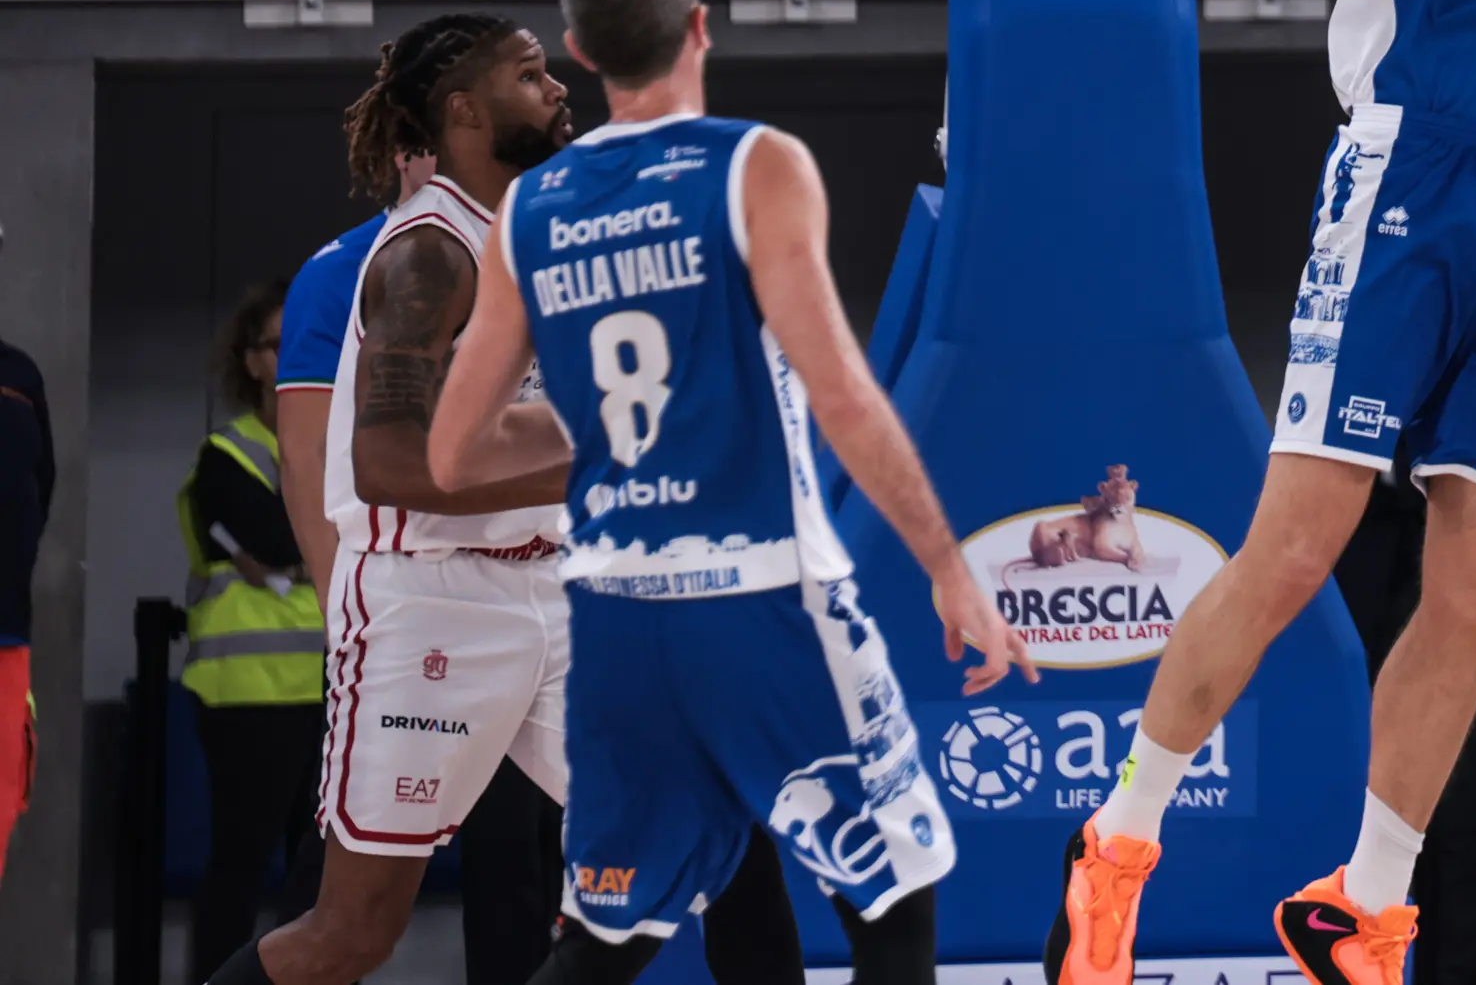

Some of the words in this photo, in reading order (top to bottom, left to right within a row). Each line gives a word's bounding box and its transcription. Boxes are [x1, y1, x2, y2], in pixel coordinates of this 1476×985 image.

[550, 201, 682, 251] bonera.
[533, 252, 614, 317] DELLA
[612, 236, 706, 298] VALLE
[589, 310, 672, 468] 8
[672, 565, 741, 594] D'ITALIA
[997, 583, 1174, 627] BRESCIA
[1018, 626, 1082, 644] NTRALE
[1089, 625, 1119, 641] DEL
[1127, 623, 1174, 639] LATTE
[381, 715, 469, 735] DRIVALIA
[396, 777, 440, 798] EA7
[1055, 788, 1102, 809] LIFE
[578, 866, 637, 893] RAY
